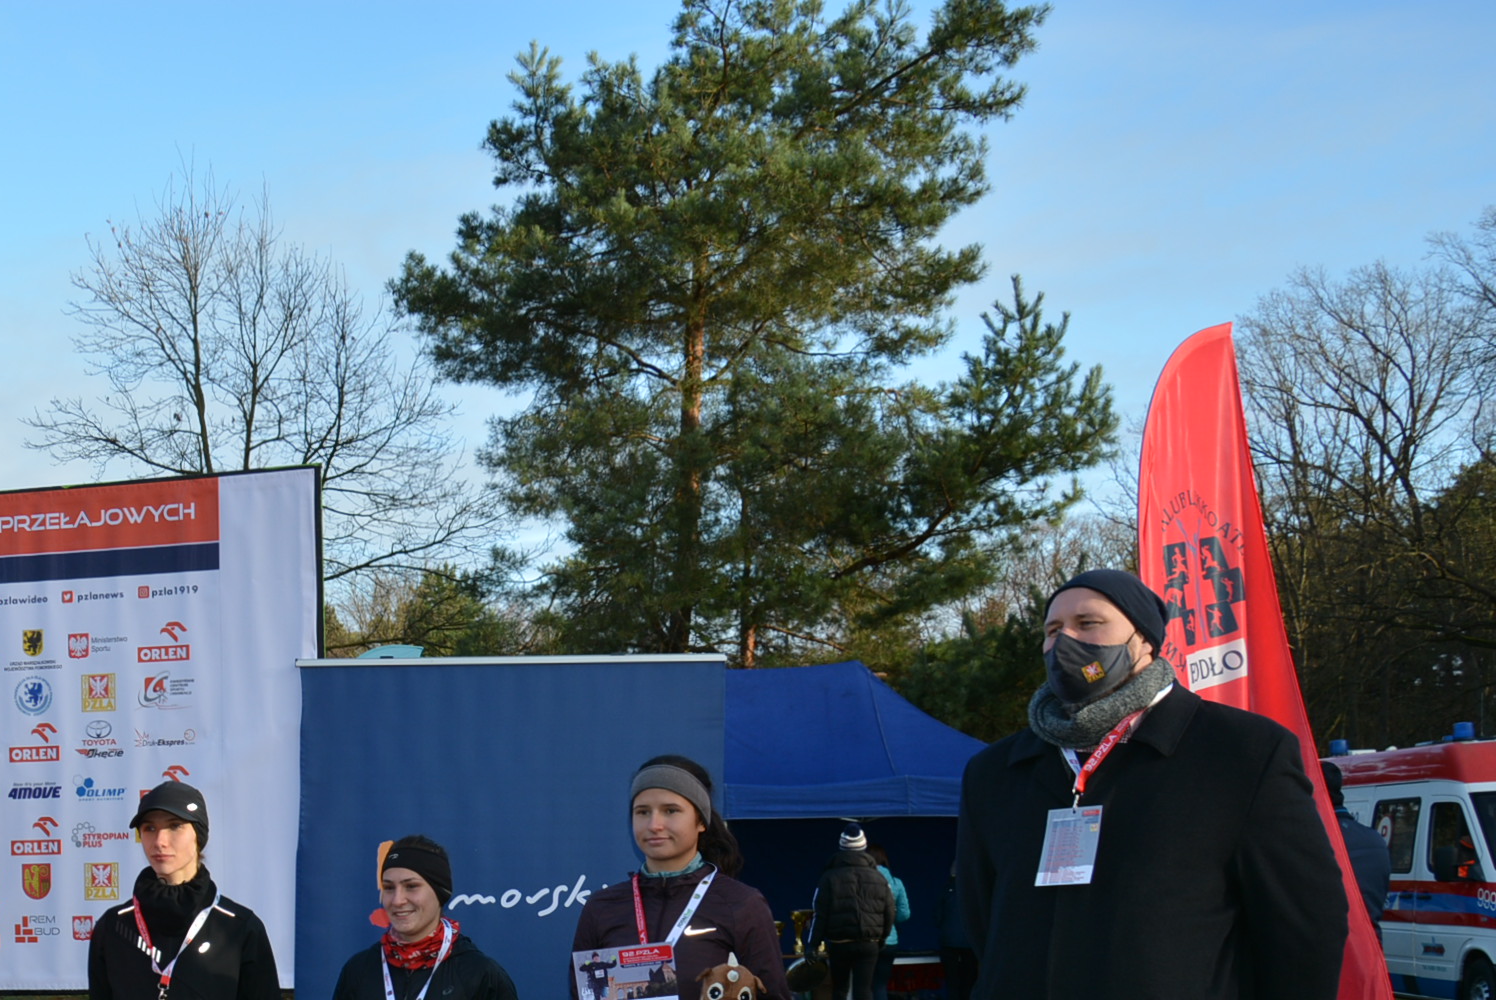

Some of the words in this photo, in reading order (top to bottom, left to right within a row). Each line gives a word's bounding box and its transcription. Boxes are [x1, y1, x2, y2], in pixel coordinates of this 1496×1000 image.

[77, 590, 124, 603] pzlanews
[152, 585, 199, 599] pzla1919
[140, 647, 187, 661] ORLEN
[84, 700, 114, 710] PZLA
[12, 748, 57, 761] ORLEN
[8, 786, 62, 800] 4MOVE
[87, 788, 125, 797] OLIMP
[82, 832, 129, 841] STYROPIAN
[14, 841, 58, 854] ORLEN
[86, 888, 118, 899] PZLA
[448, 875, 592, 917] morsk
[29, 915, 56, 925] REM
[34, 926, 60, 936] BUD
